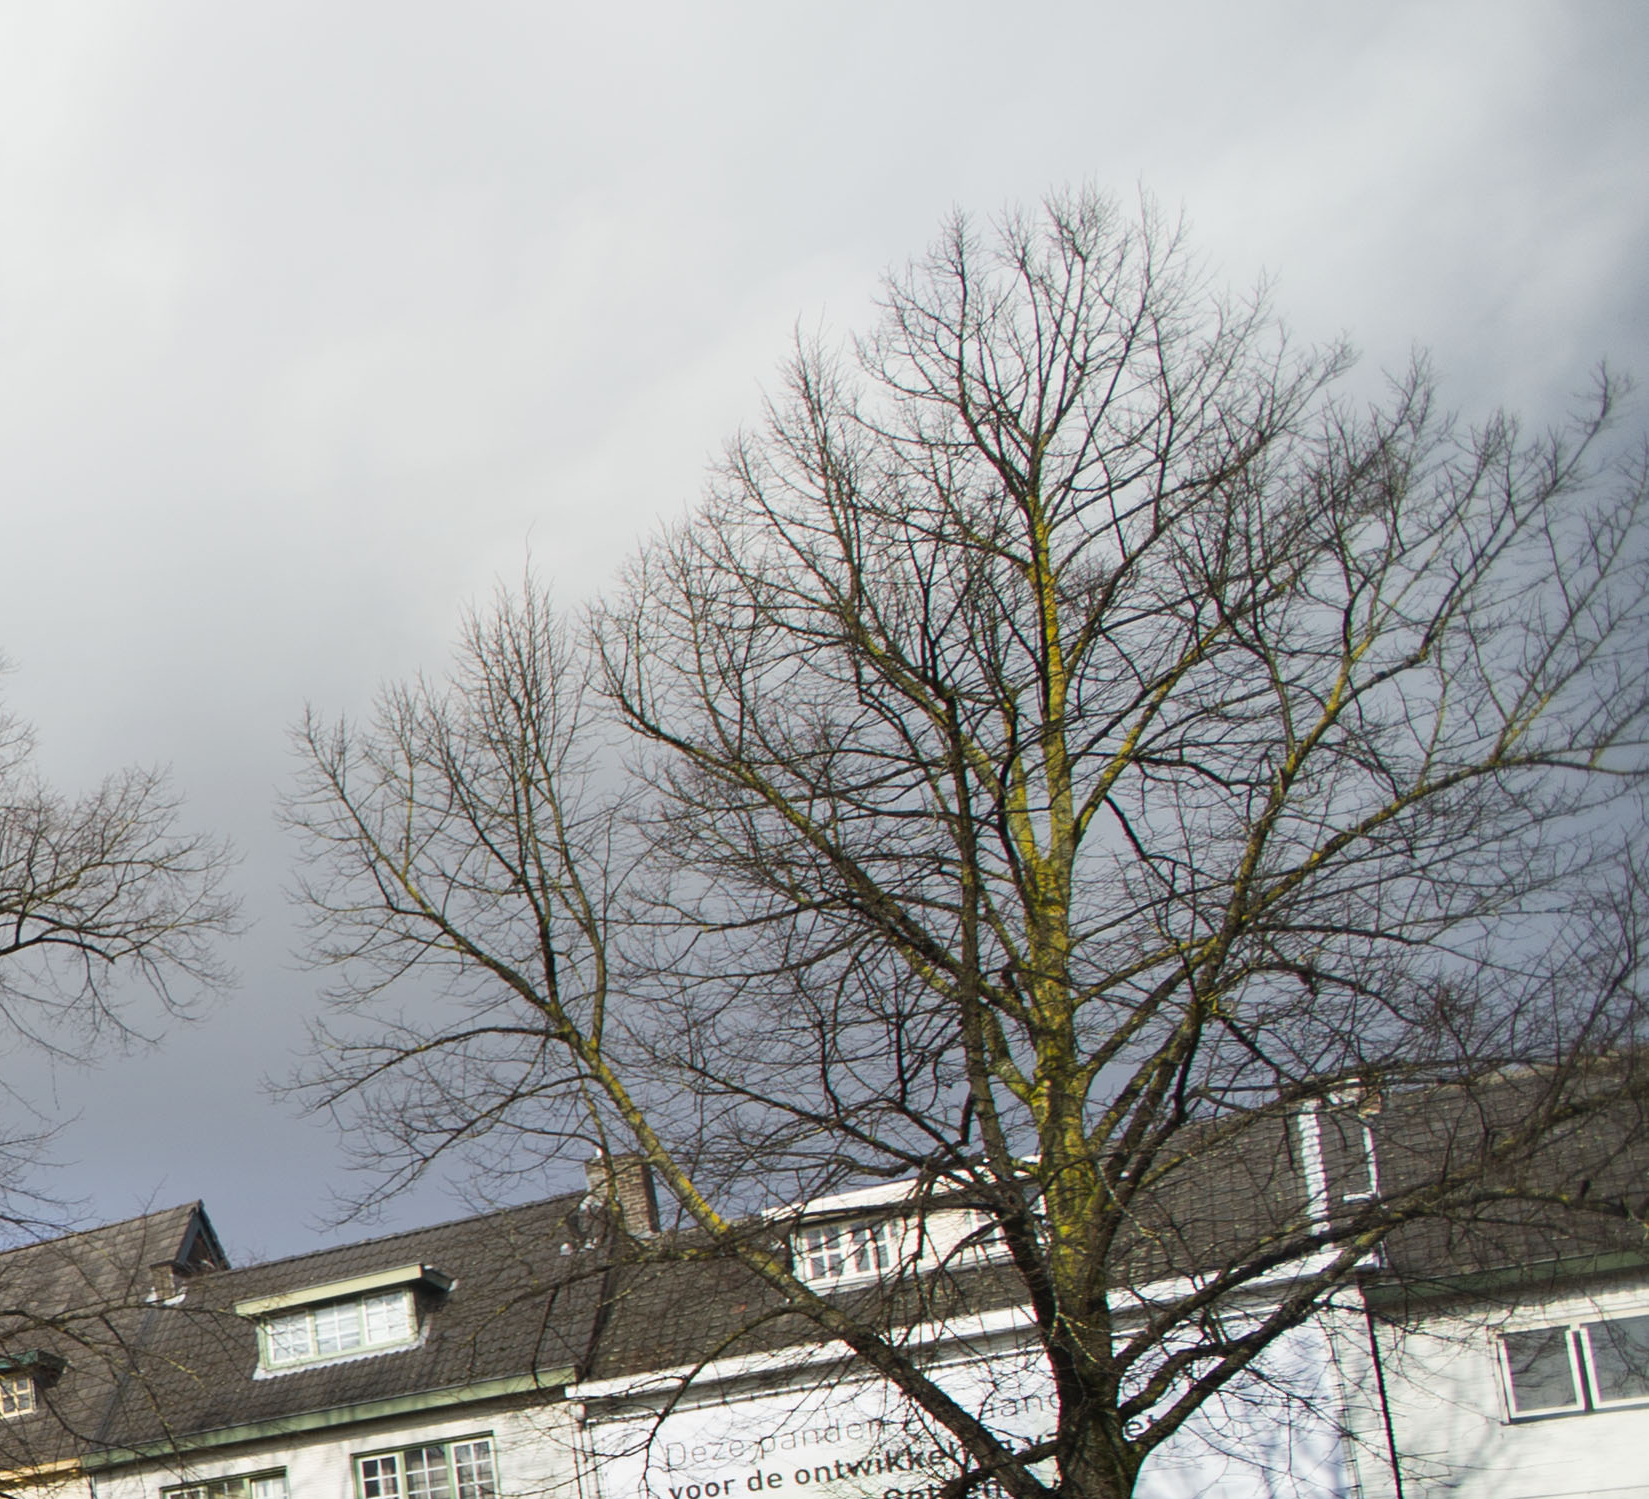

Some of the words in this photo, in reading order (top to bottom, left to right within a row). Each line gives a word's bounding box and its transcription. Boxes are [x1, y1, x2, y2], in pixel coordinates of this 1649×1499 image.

[666, 1440, 744, 1466] Deze
[759, 1418, 886, 1459] panden
[747, 1468, 783, 1492] de
